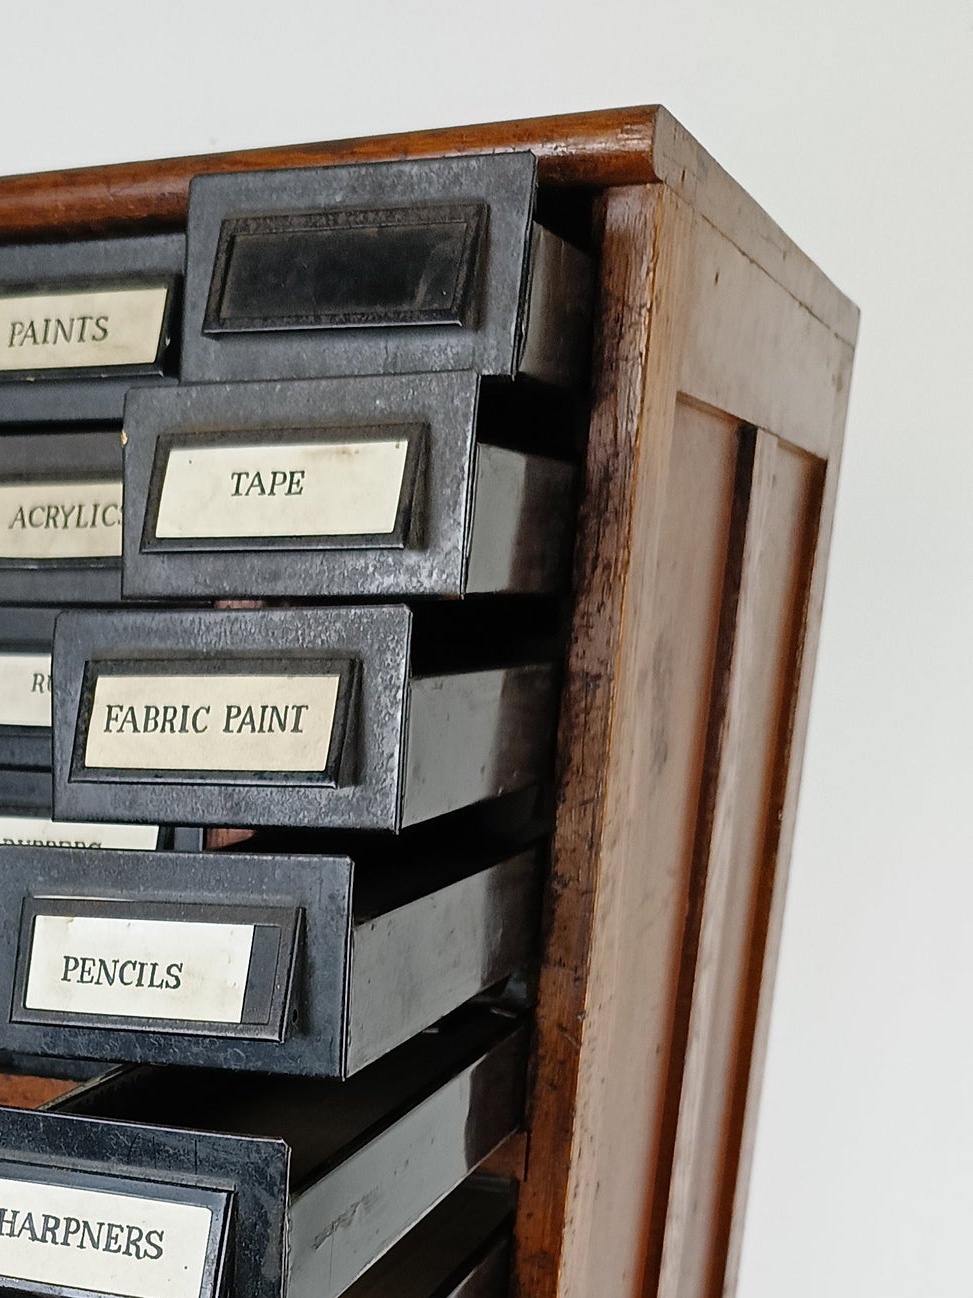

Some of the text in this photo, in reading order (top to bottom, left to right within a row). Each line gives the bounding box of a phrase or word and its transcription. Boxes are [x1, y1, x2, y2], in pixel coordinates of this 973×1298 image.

[8, 315, 109, 348] PAINTS
[231, 470, 306, 497] TAPE
[103, 704, 309, 733] FABRIC PAINT
[61, 955, 183, 990] PENCILS
